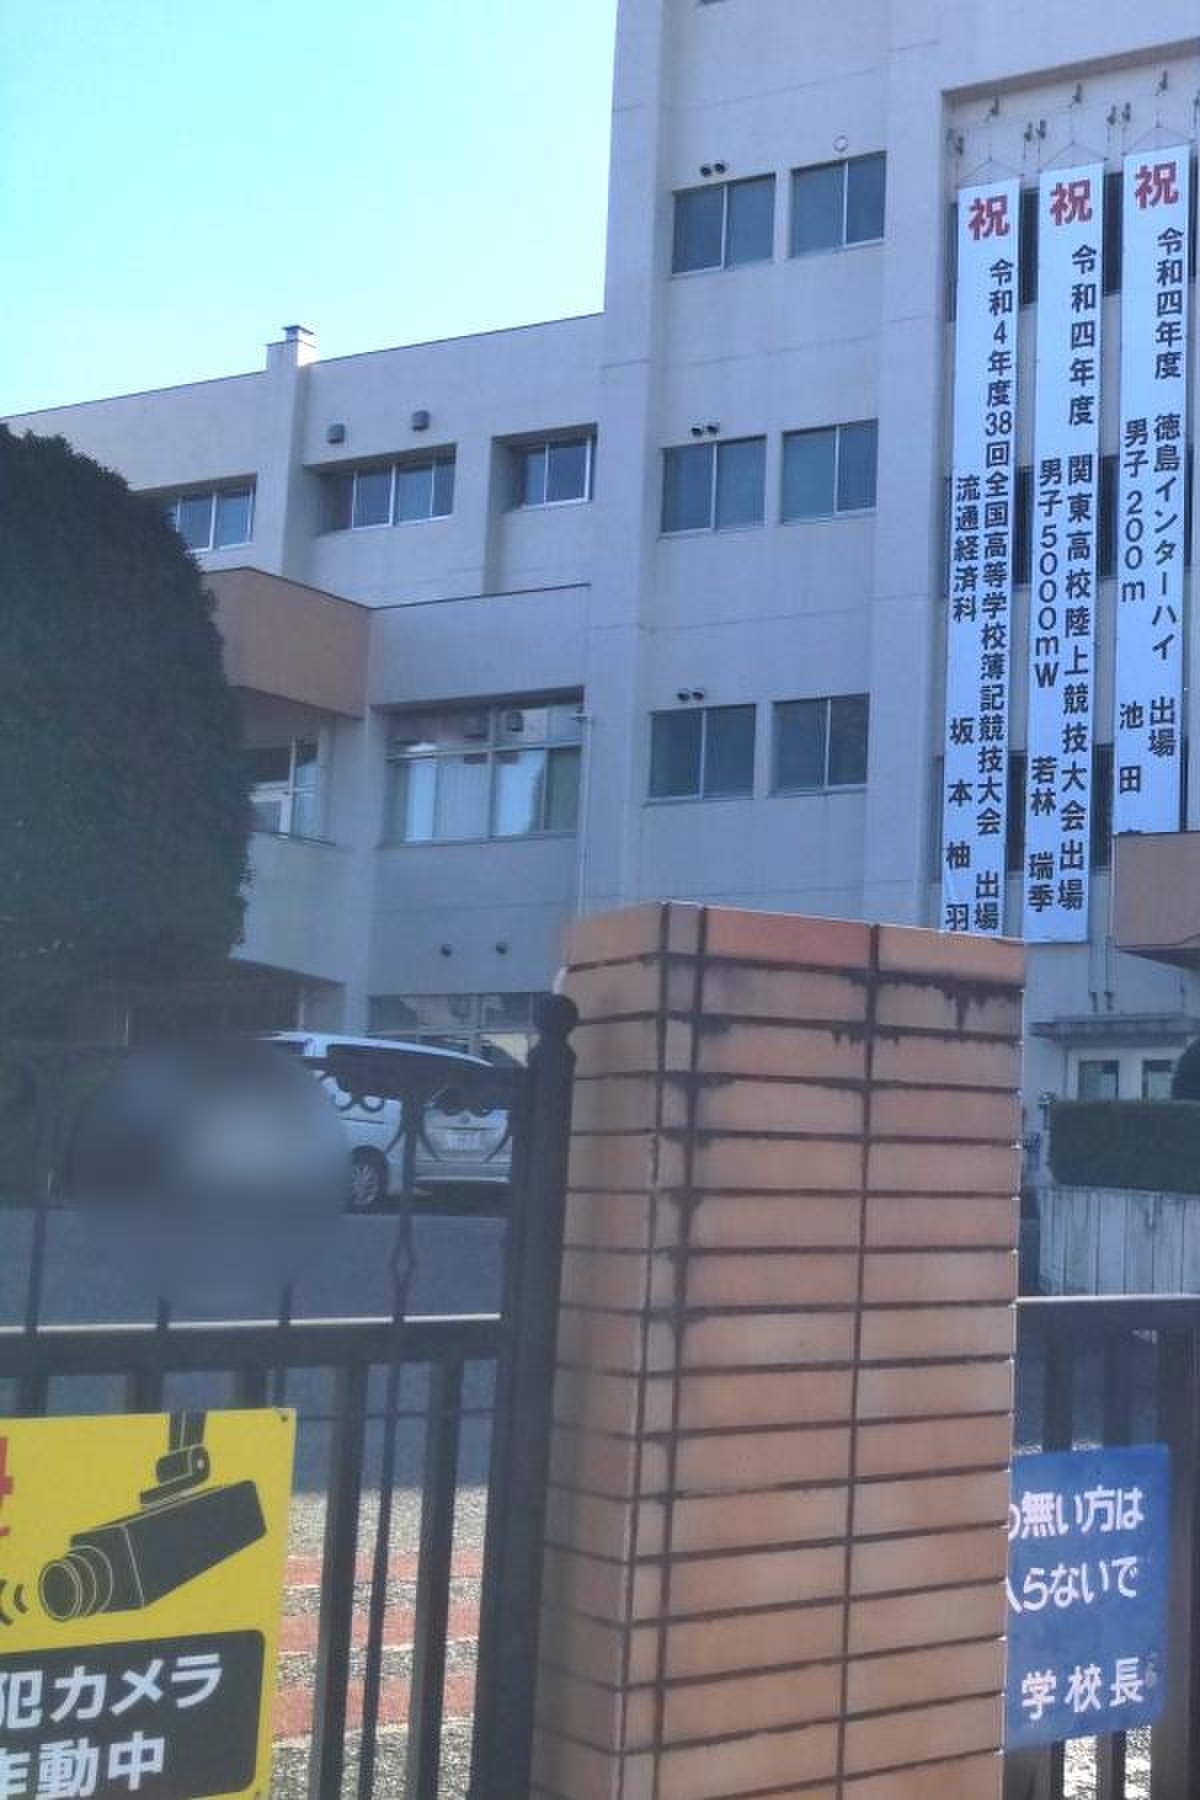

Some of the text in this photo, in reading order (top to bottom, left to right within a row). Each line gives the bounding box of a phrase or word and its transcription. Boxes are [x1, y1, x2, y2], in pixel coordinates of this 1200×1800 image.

[1050, 178, 1093, 226] 祝
[1135, 161, 1180, 209] 祝
[968, 194, 1010, 240] 祝
[1068, 244, 1098, 427] 令和四年度
[1149, 226, 1184, 758] 令和四年度 徳島インターハイ 出場
[953, 474, 981, 624] 流通経済科
[974, 870, 999, 930] 出場
[1020, 1656, 1144, 1720] 学校長
